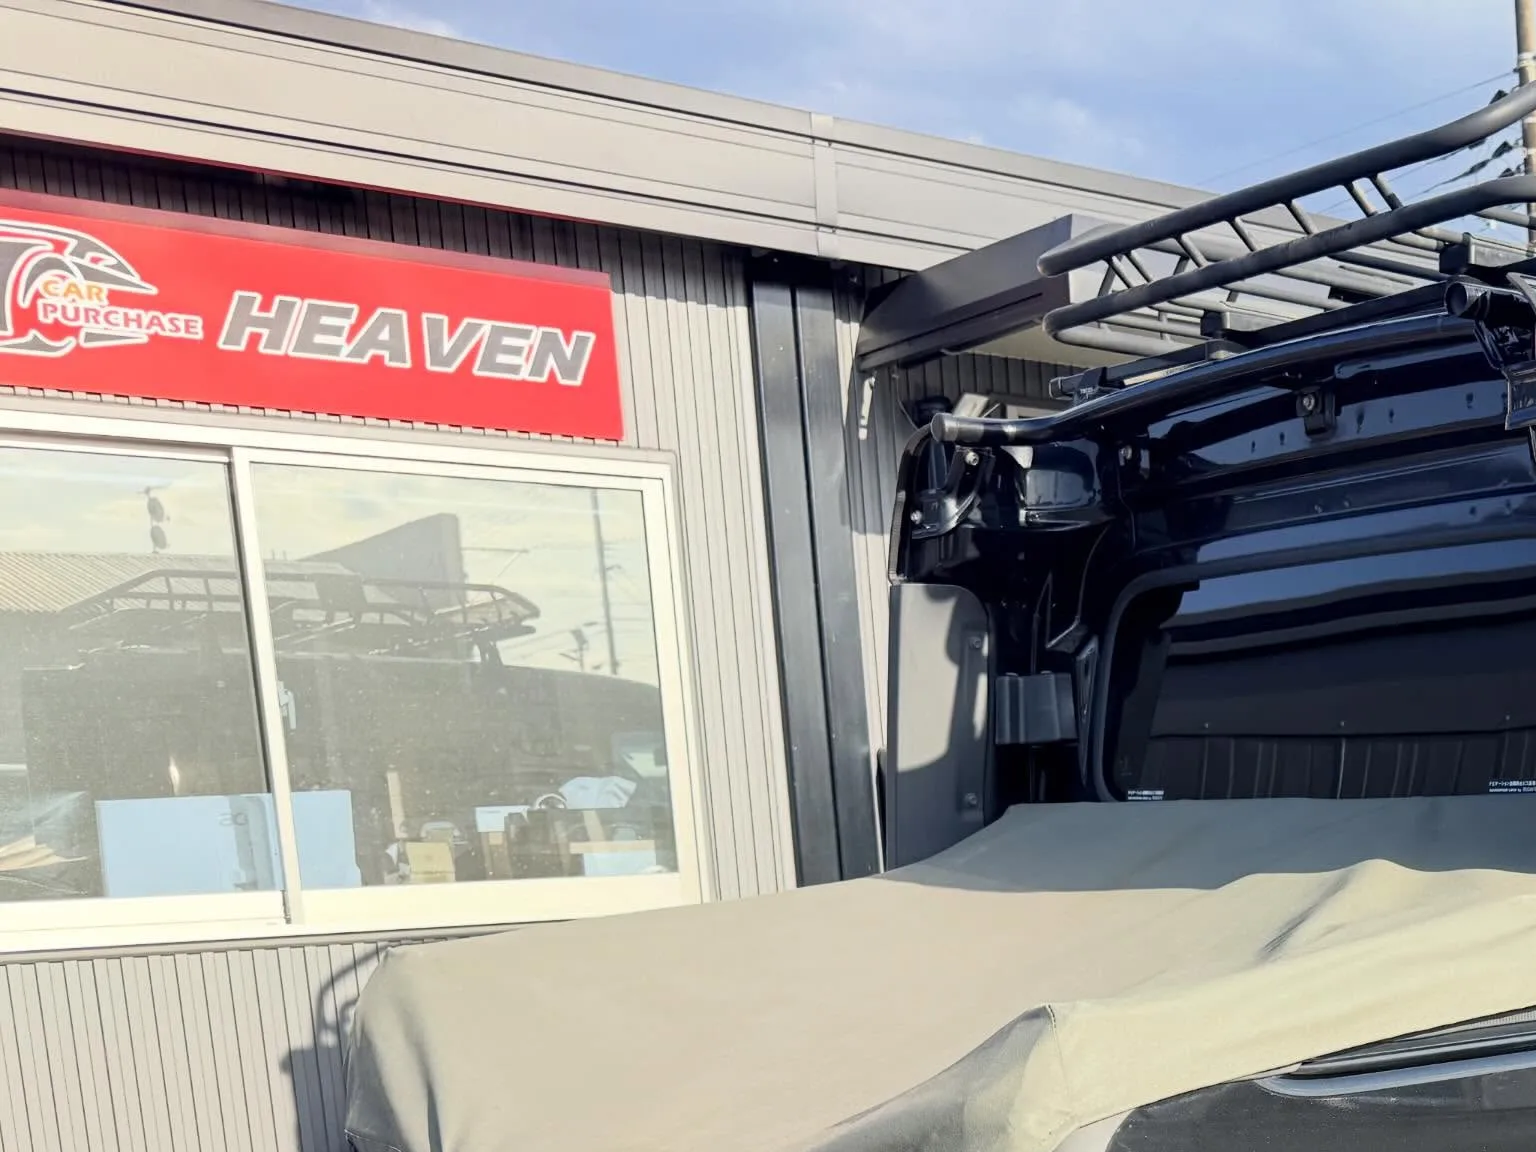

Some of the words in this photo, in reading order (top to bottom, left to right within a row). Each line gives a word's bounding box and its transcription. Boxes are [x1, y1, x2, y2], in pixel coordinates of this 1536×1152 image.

[41, 279, 106, 303] CAR
[40, 301, 203, 337] PURCHASE
[218, 290, 595, 386] HEAVEN
